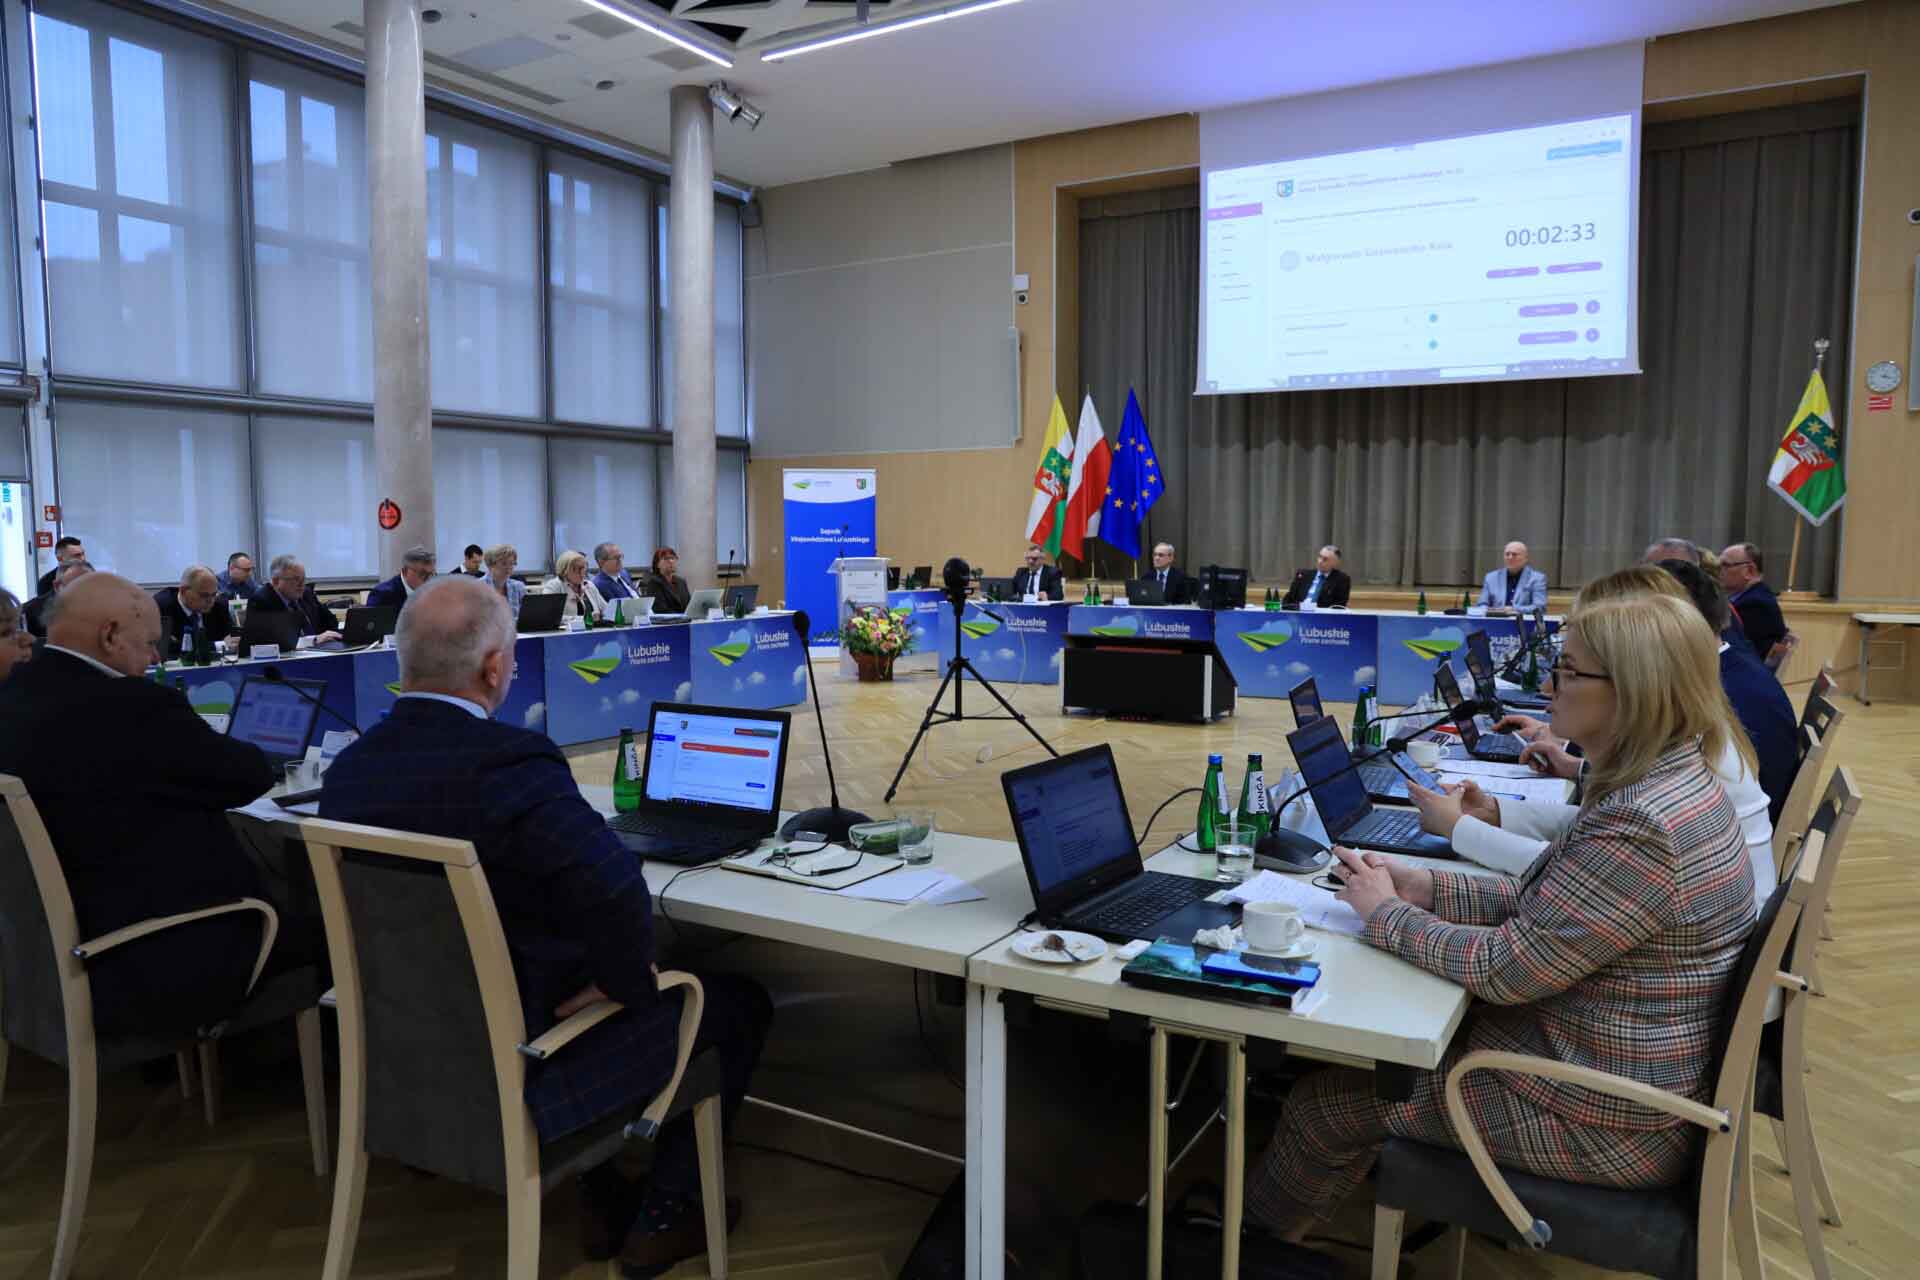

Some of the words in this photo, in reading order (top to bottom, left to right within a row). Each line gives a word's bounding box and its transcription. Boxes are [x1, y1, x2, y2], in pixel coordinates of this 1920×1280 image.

[1505, 222, 1595, 247] 00:02:33
[1007, 616, 1048, 627] Lubuskie
[1144, 620, 1190, 633] Lubuskie
[755, 630, 789, 644] Lubuskie
[1299, 625, 1350, 639] Lubuskie
[628, 642, 671, 658] Lubuskie
[1256, 775, 1265, 810] KINGA
